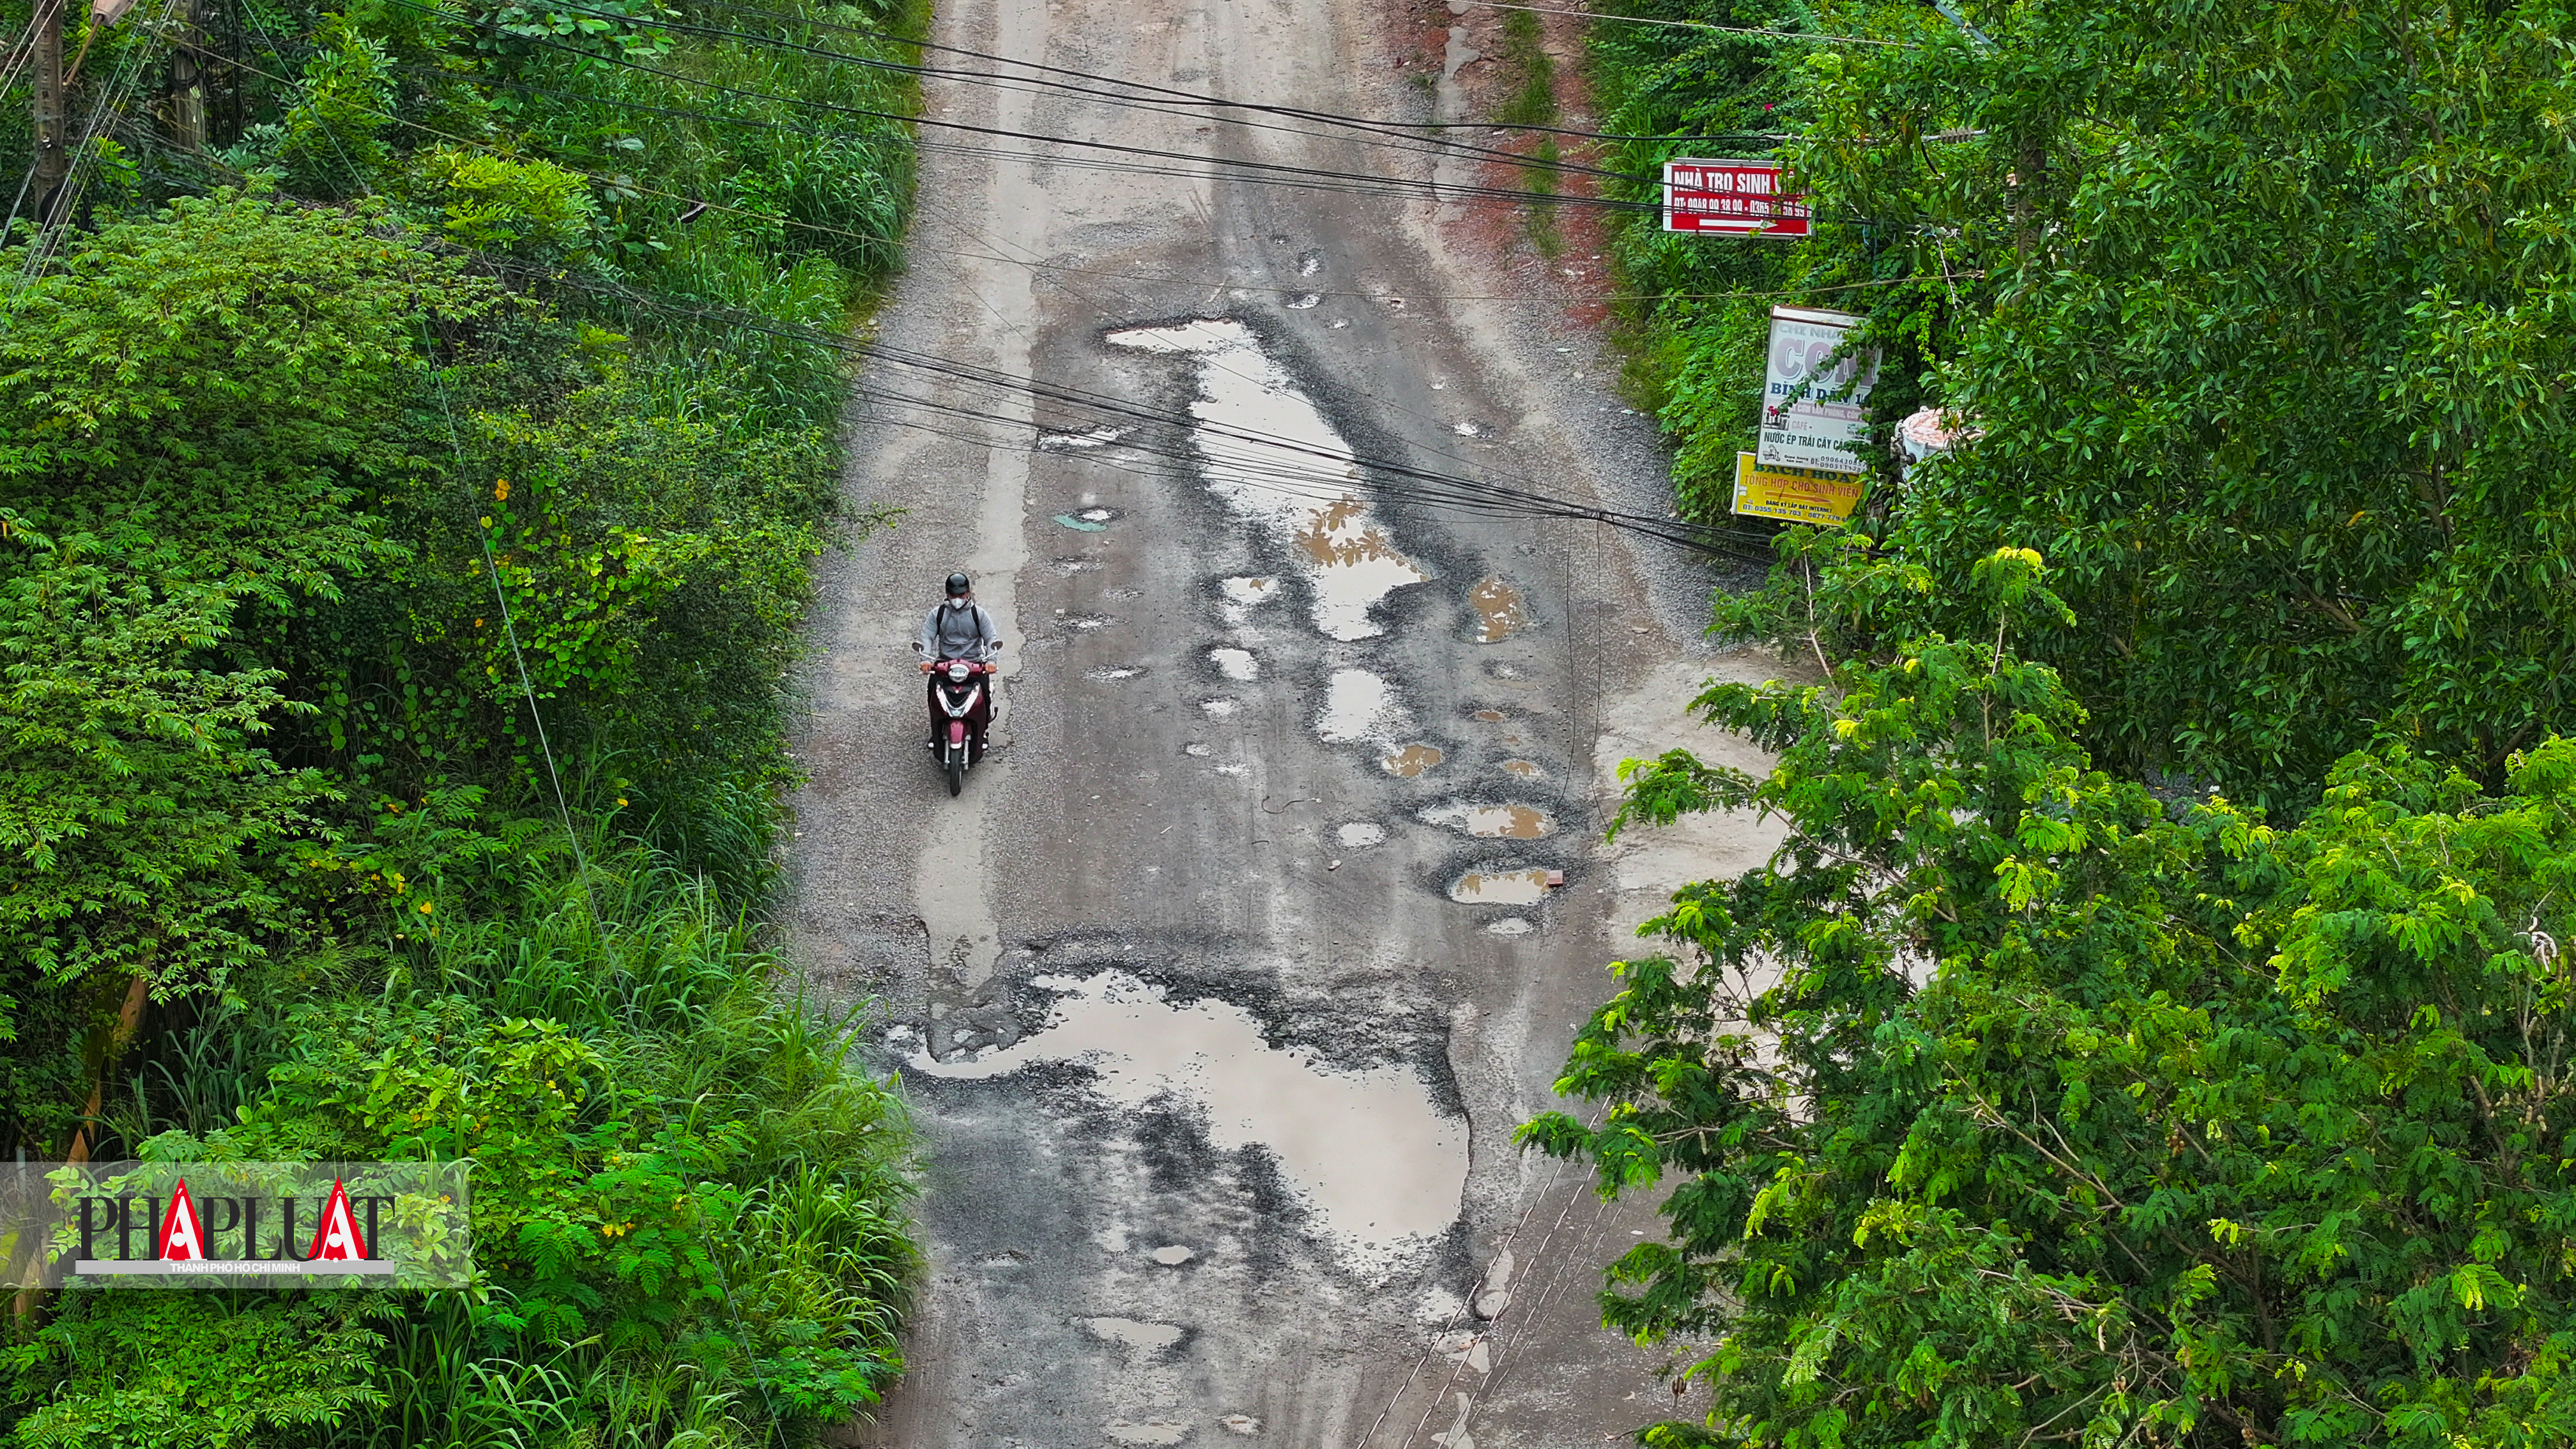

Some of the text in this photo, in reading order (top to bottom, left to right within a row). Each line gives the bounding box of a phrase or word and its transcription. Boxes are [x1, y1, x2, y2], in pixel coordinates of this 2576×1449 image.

[1675, 168, 1703, 192] NHÀ
[1706, 172, 1733, 197] TRỌ
[1736, 172, 1770, 194] SINH
[1764, 431, 1784, 444] NƯỚC
[1786, 431, 1797, 445] ÉP
[1798, 434, 1815, 447] TRÁI
[1816, 436, 1832, 449] CÂY
[1792, 480, 1810, 492] CHO
[1813, 484, 1835, 495] SINH
[1837, 486, 1859, 498] VIÊN
